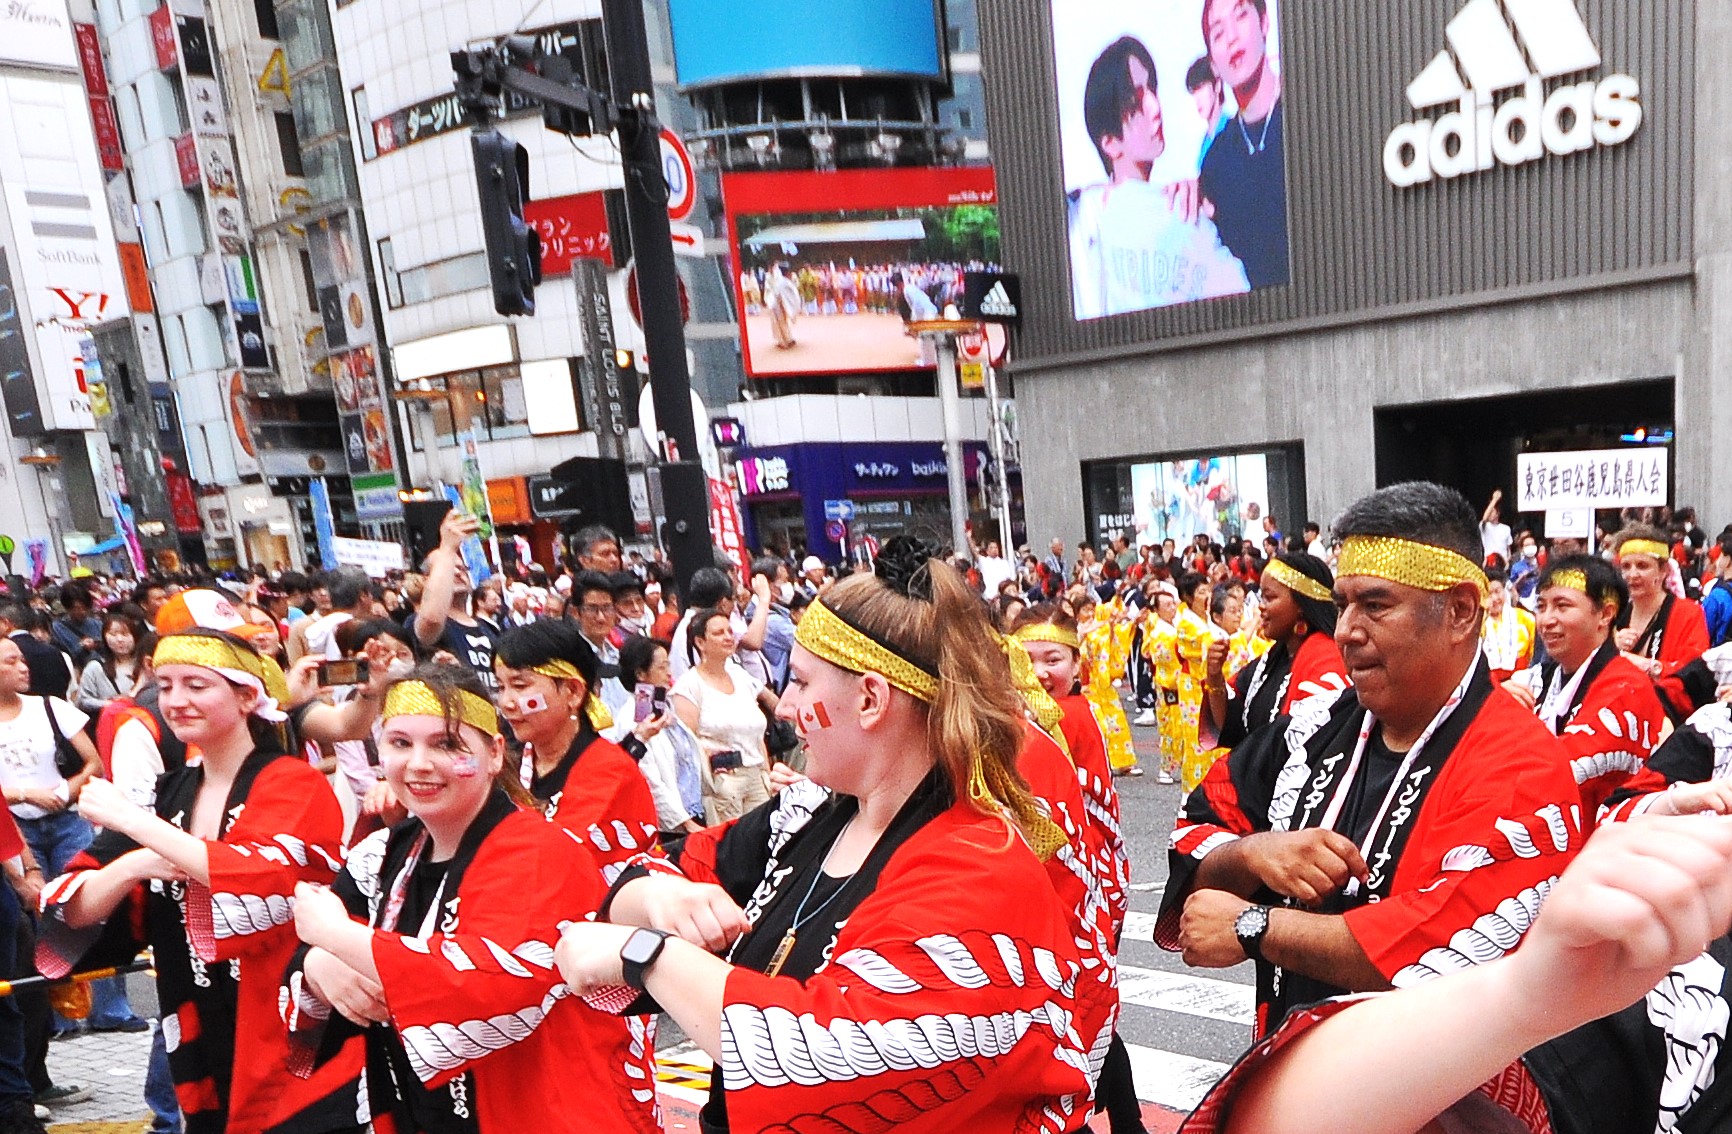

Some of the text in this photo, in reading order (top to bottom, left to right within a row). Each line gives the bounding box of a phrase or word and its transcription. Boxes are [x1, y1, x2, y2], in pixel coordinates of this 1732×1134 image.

[1383, 73, 1643, 189] adidas
[36, 250, 104, 265] SoftBank
[46, 286, 109, 320] Y!
[1524, 456, 1662, 501] 東京世田谷鹿児島県人会
[1561, 512, 1574, 528] 5
[467, 650, 492, 667] BO
